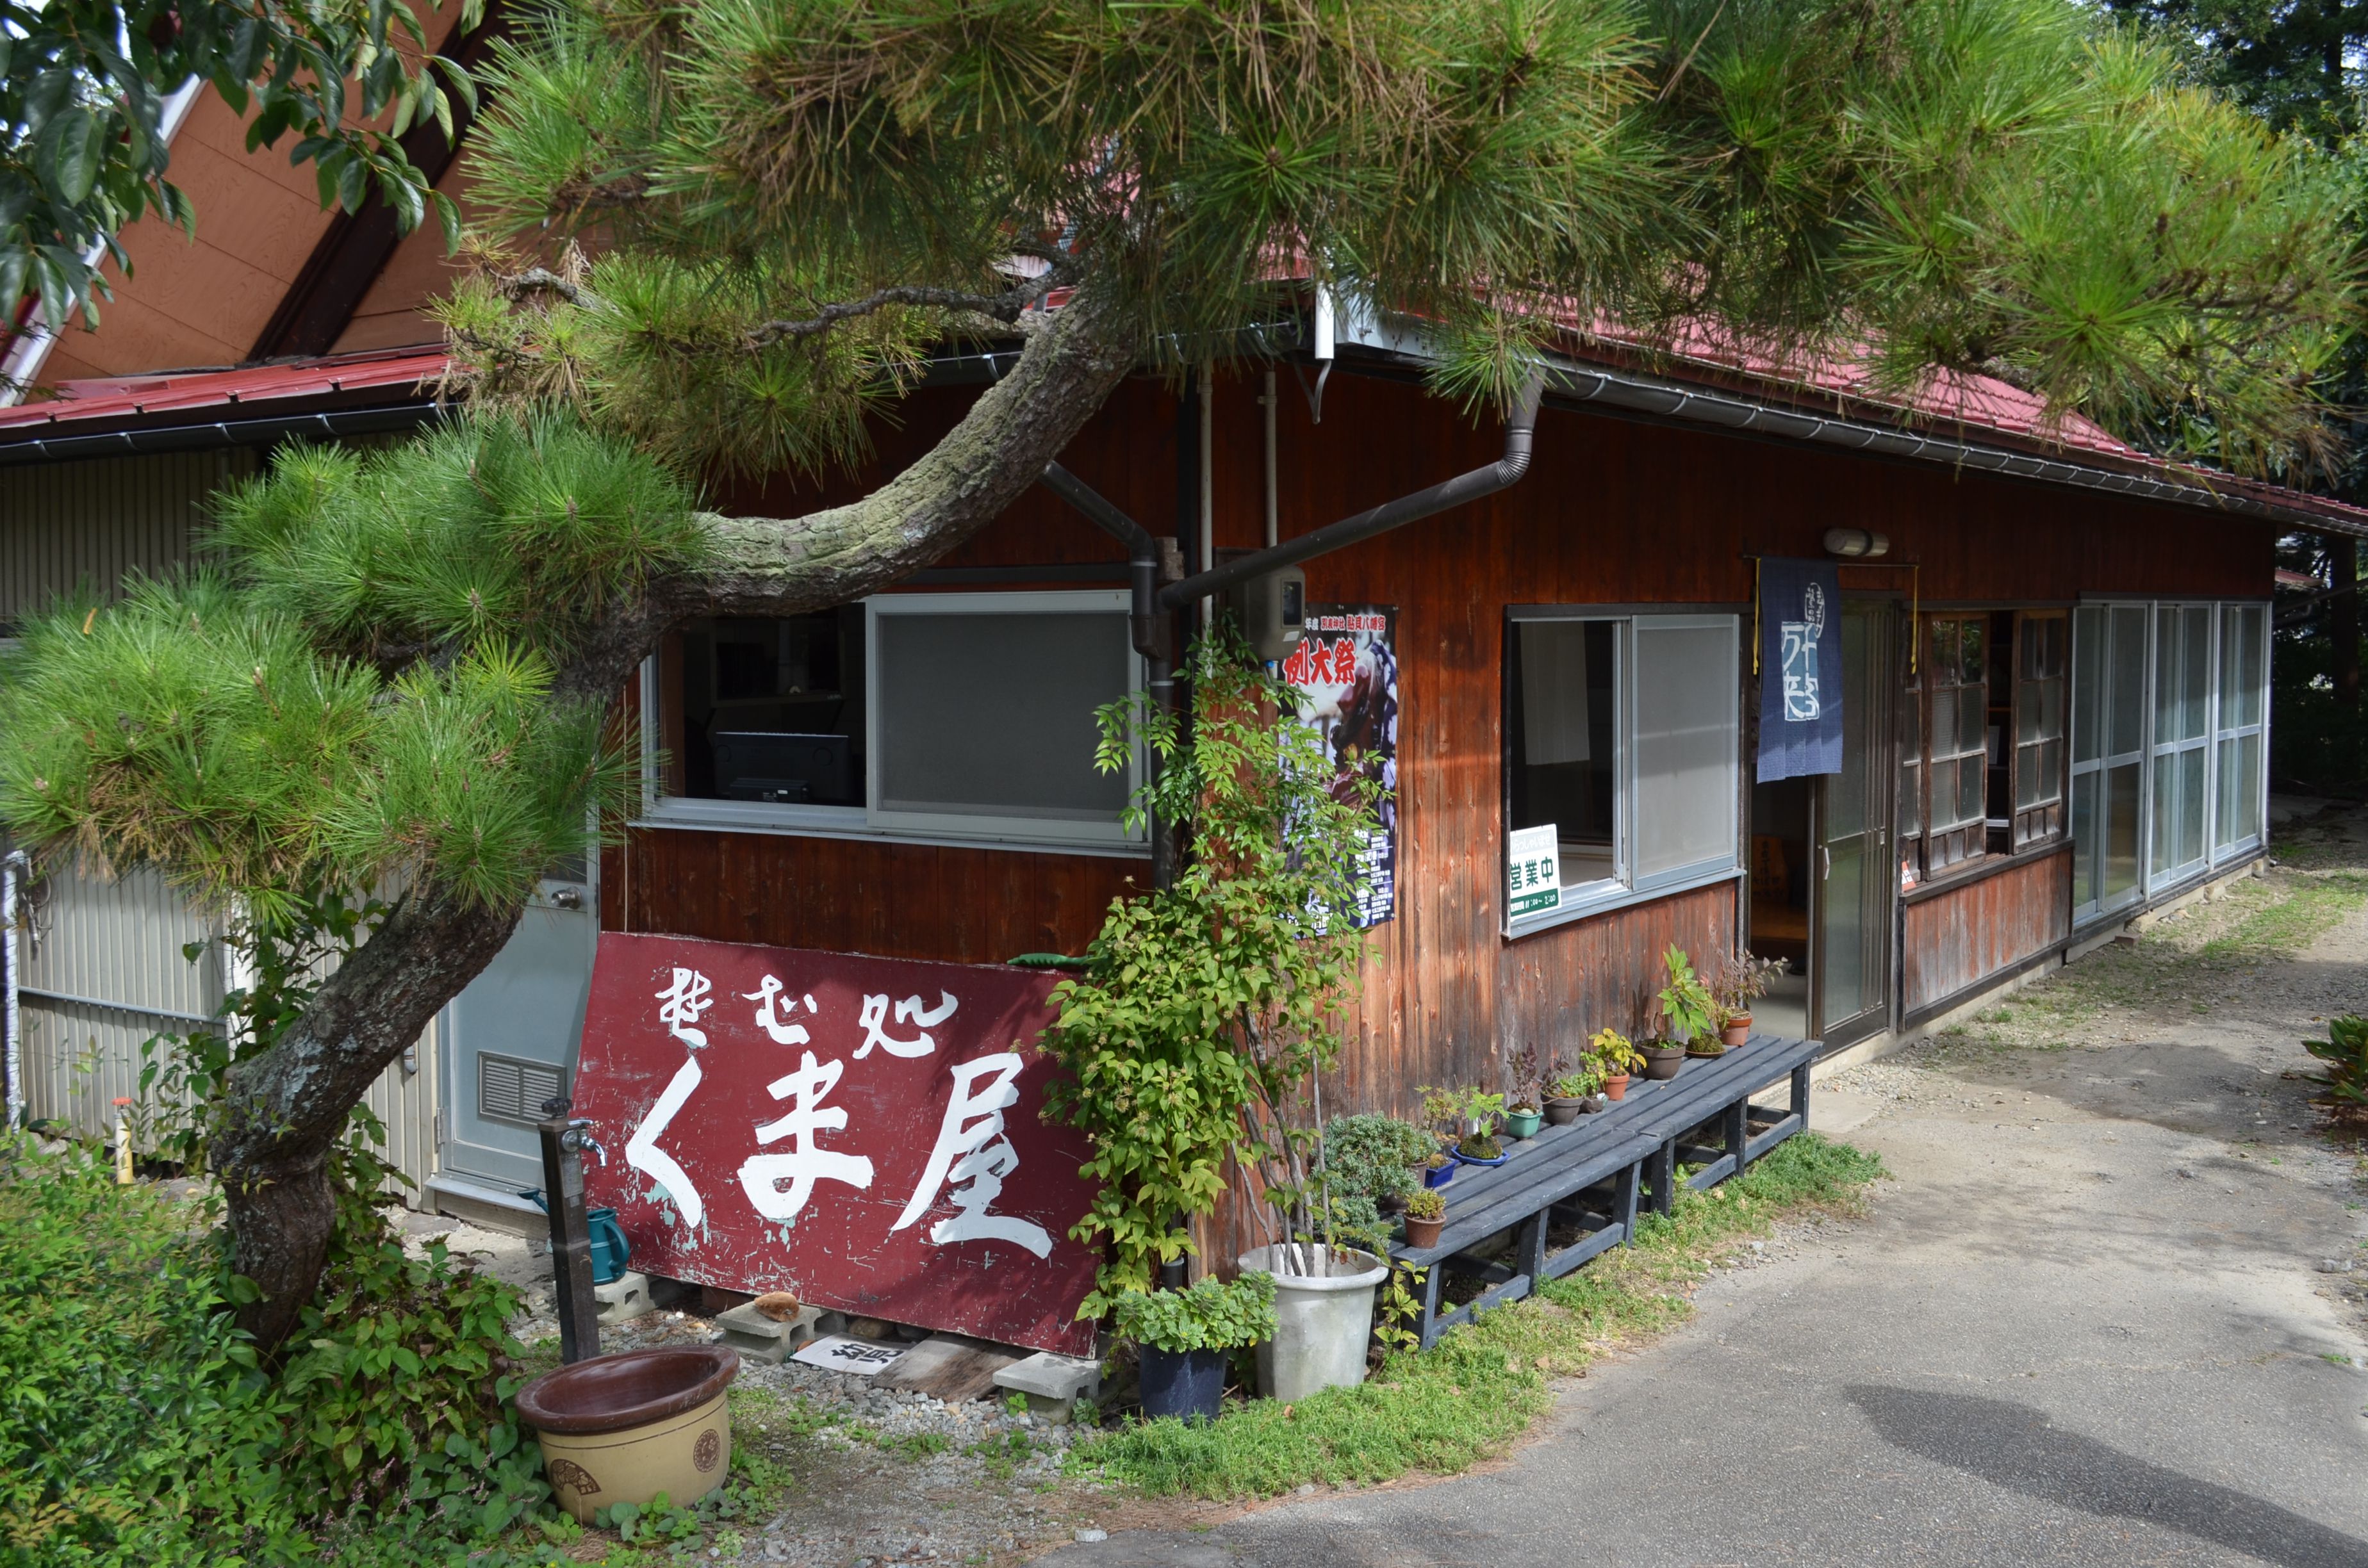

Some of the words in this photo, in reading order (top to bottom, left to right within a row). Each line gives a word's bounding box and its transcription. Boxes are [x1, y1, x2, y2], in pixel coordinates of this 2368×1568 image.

[1510, 856, 1554, 891] 営業中
[625, 1050, 1053, 1260] くま屋
